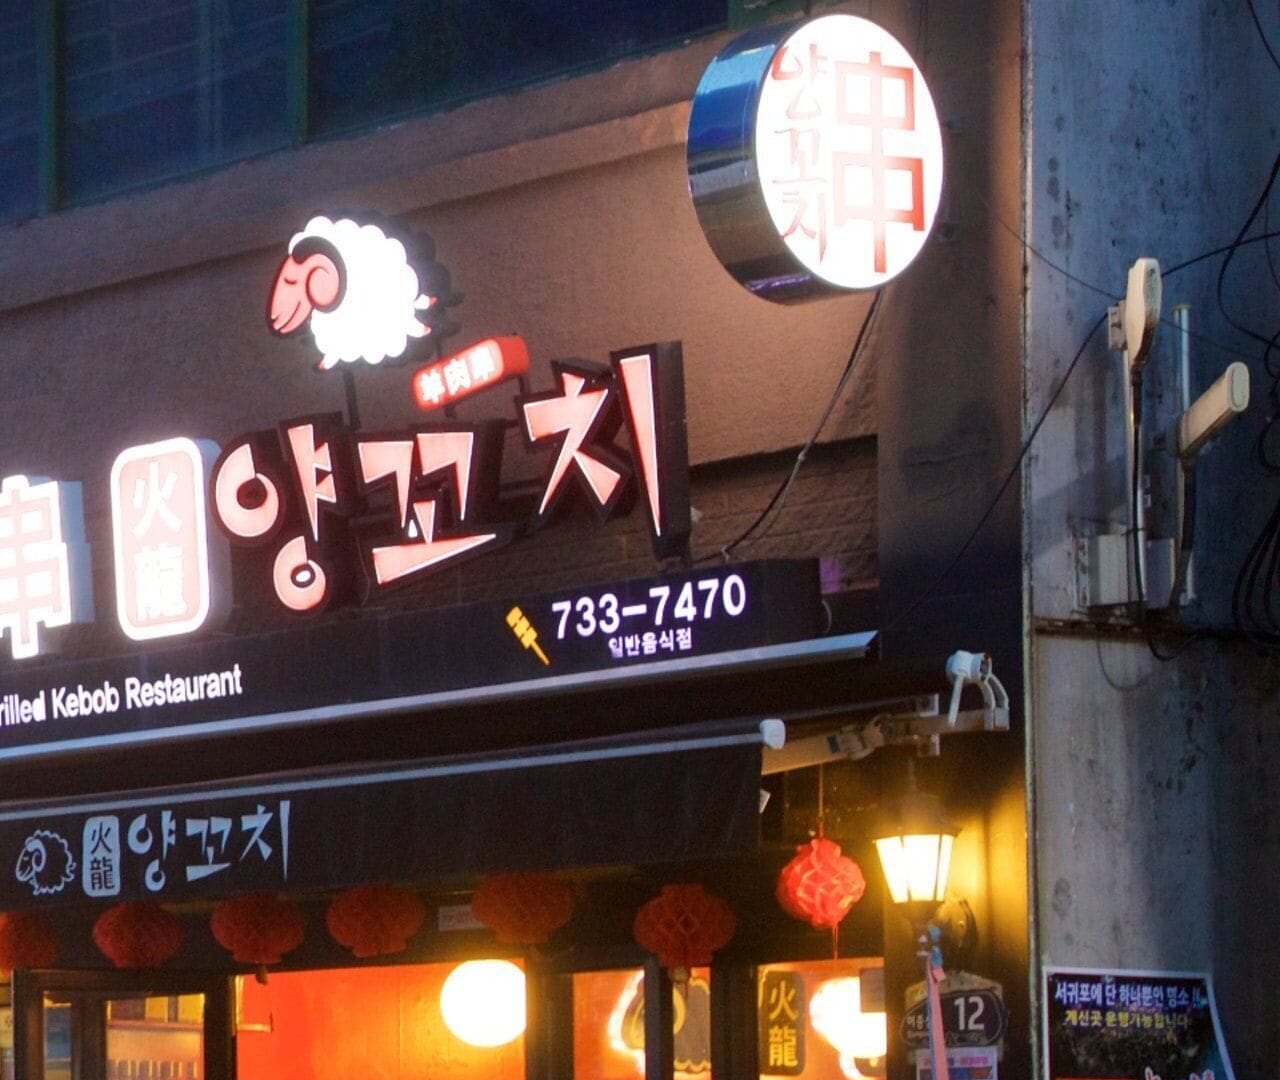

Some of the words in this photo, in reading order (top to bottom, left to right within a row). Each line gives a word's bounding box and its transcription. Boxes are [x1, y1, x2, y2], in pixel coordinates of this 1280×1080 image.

[771, 43, 829, 264] 양꼬치
[215, 353, 662, 612] 양꼬치
[551, 574, 747, 639] 733-7470
[607, 626, 693, 660] 일반음식점
[52, 681, 121, 720] Kebob
[125, 663, 243, 709] Restaurant
[90, 821, 117, 892] 火龍
[127, 800, 290, 892] 양꼬치
[768, 979, 799, 1068] 火龍
[954, 995, 986, 1031] 12
